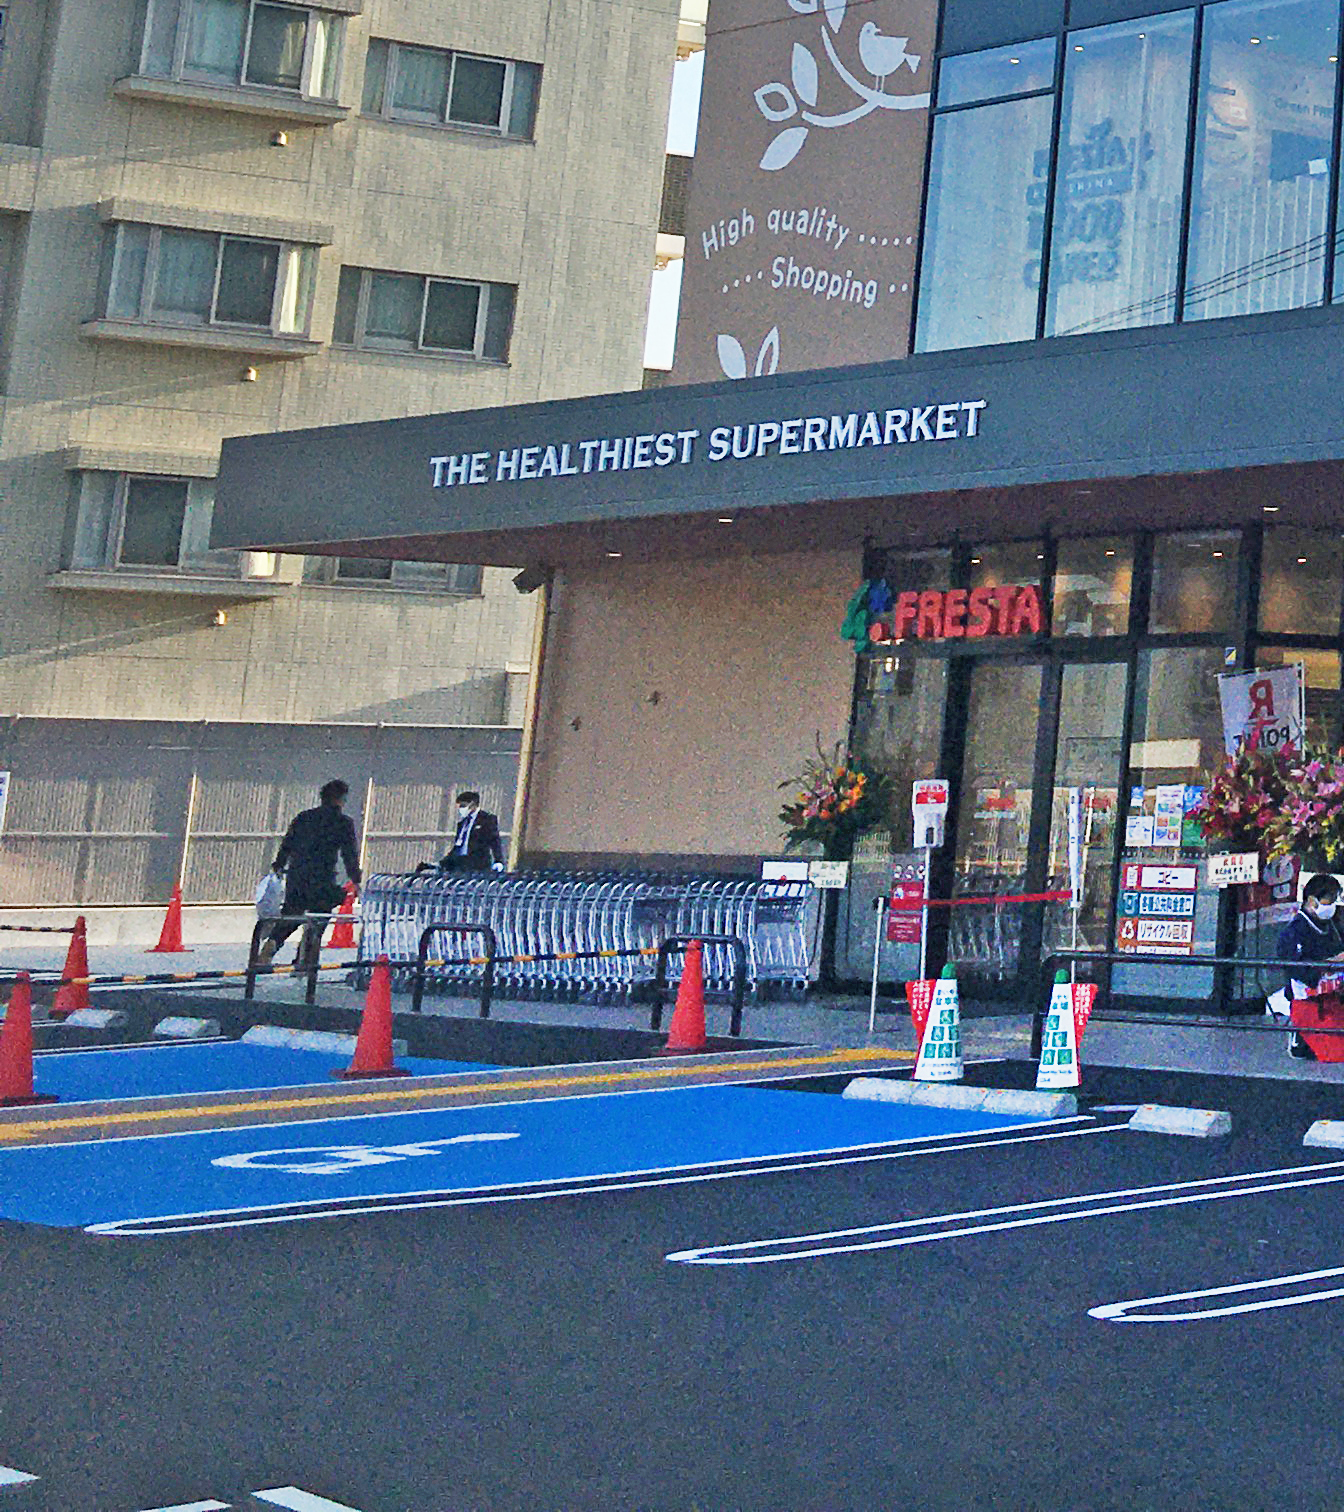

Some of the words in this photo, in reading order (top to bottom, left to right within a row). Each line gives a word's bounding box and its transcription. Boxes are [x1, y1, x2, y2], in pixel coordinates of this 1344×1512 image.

[702, 208, 755, 260] High
[766, 207, 850, 250] quality
[771, 256, 878, 308] Shopping
[430, 450, 490, 488] THE
[495, 430, 700, 483] HEALTHIEST
[708, 399, 988, 462] SUPERMARKET
[895, 583, 1045, 639] FRESTA
[1157, 870, 1179, 885] コピー
[1140, 923, 1189, 940] リサイクル回収
